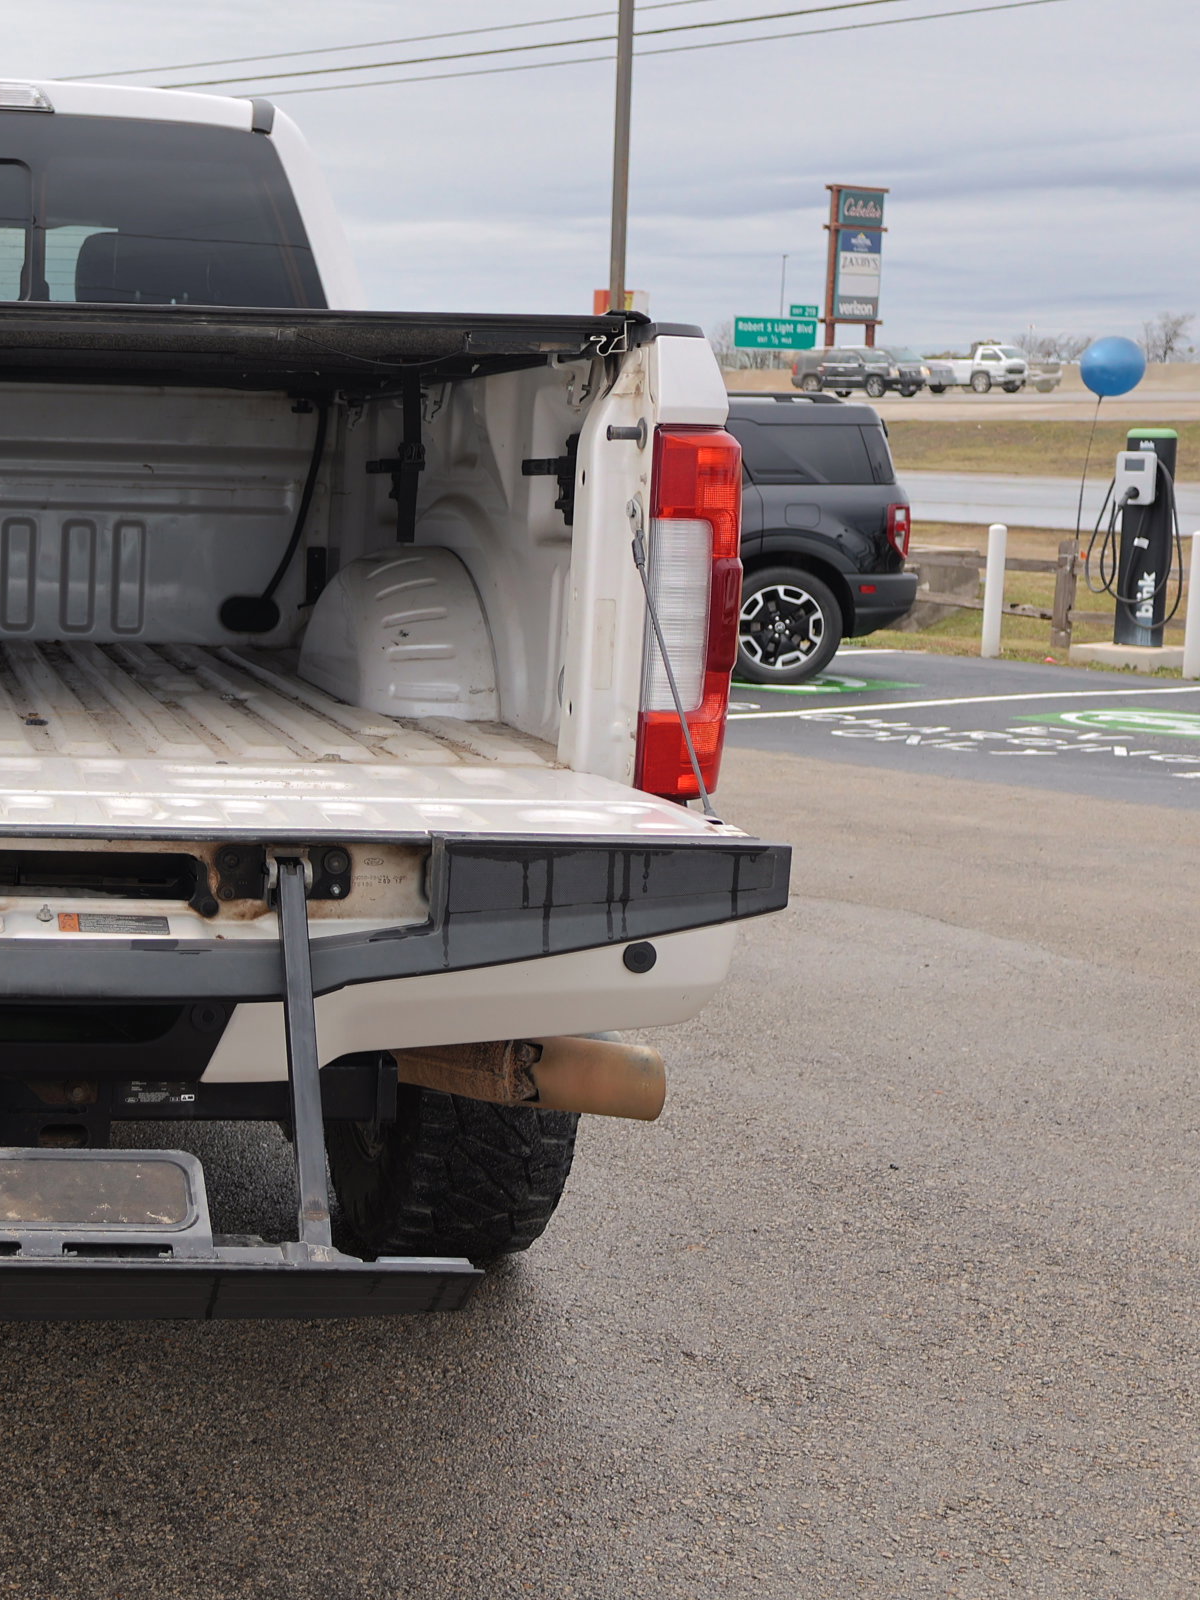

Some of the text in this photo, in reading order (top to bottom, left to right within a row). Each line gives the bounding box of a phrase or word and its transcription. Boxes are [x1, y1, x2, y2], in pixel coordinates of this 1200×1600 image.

[839, 300, 873, 316] verizon
[738, 321, 764, 332] Robert
[774, 322, 794, 336] Light
[796, 323, 814, 335] Blvd
[1136, 571, 1156, 618] blink
